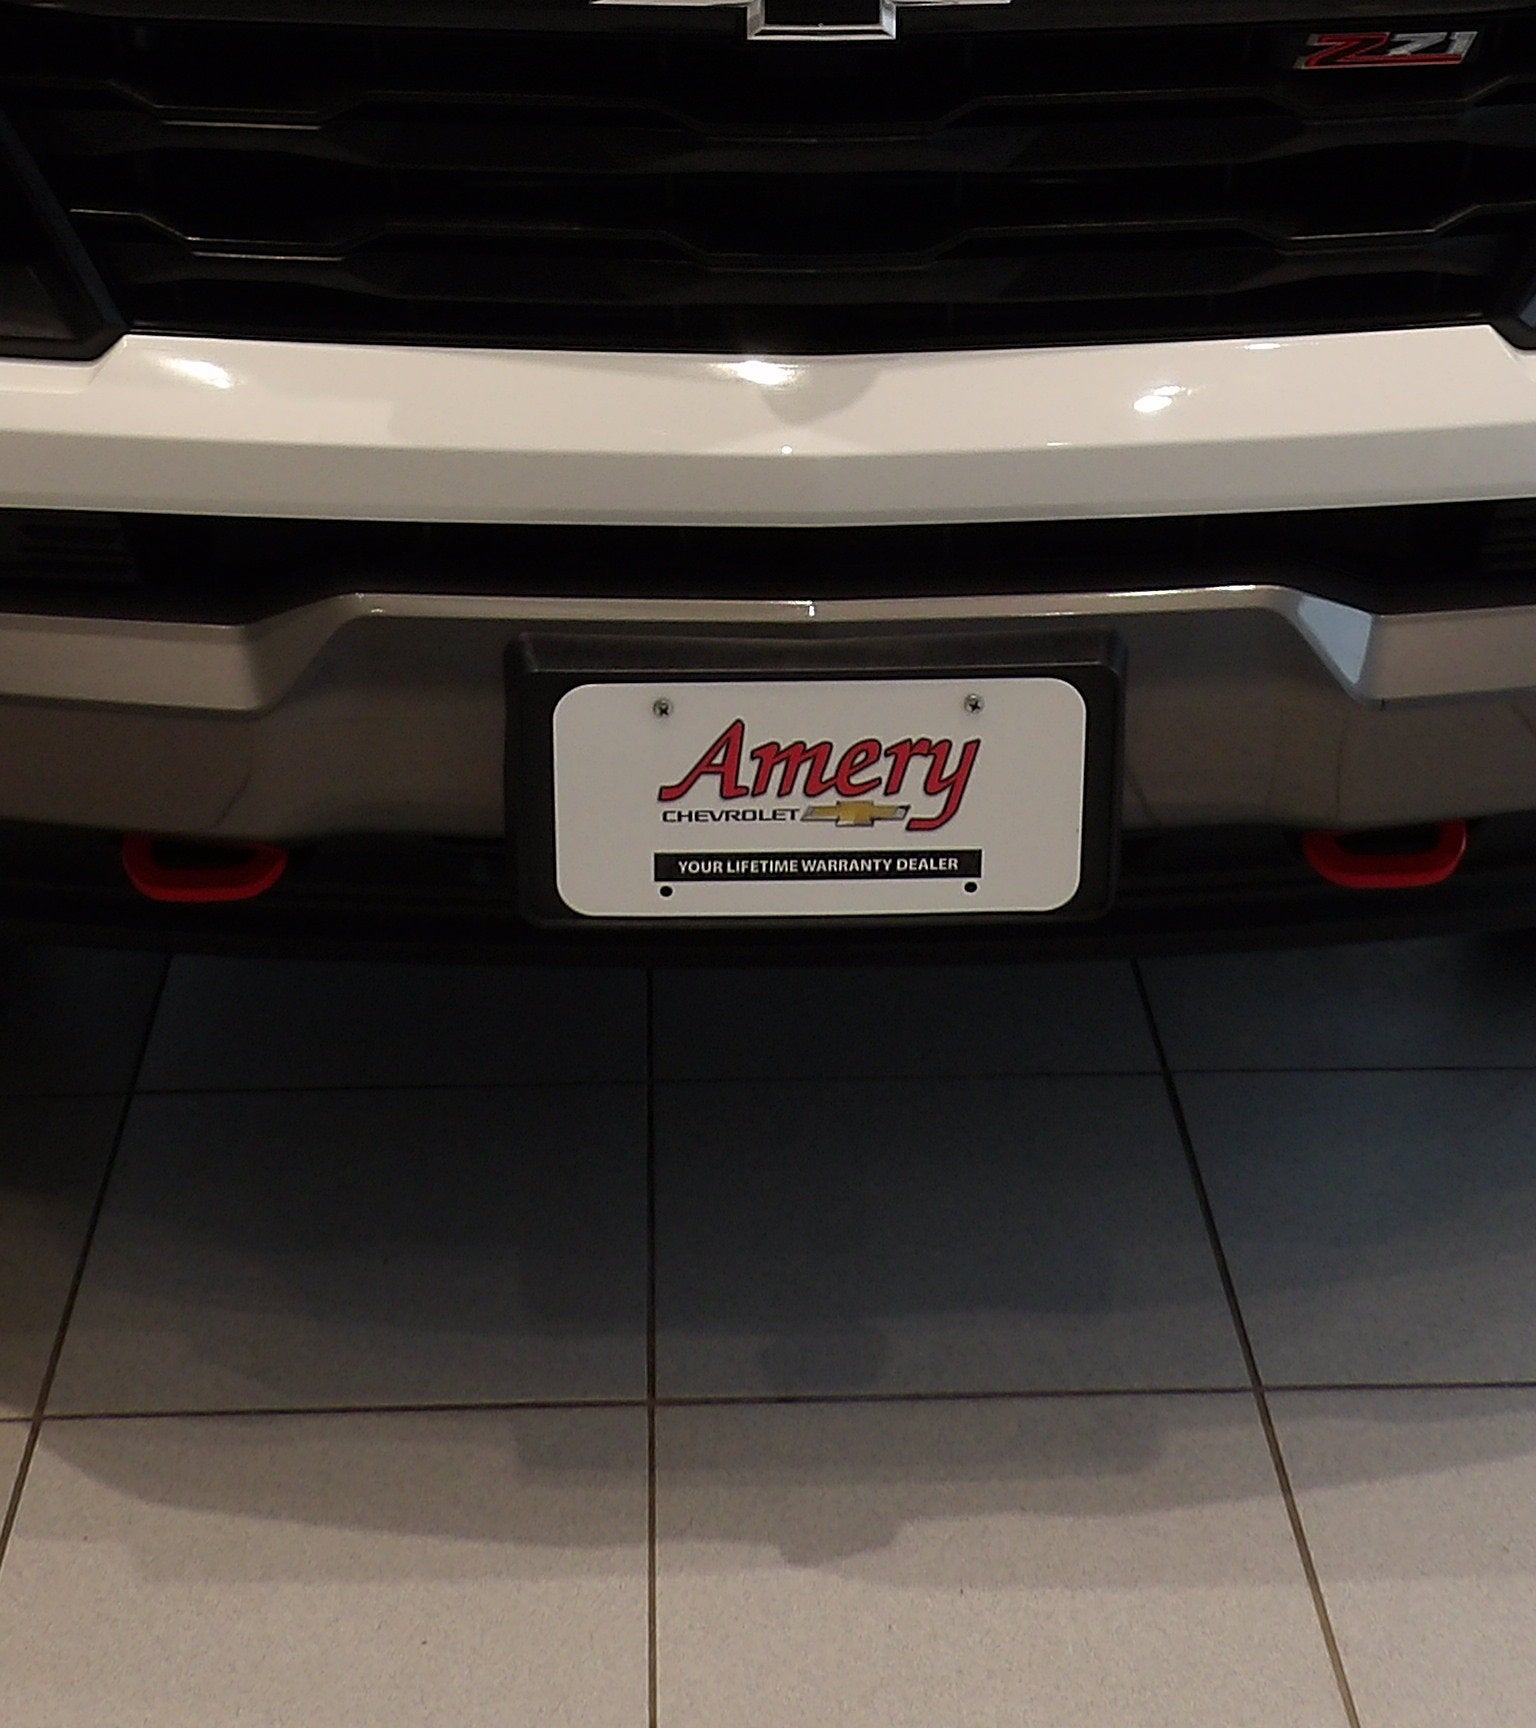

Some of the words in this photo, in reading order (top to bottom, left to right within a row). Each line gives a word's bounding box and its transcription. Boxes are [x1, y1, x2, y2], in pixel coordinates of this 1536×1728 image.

[1294, 30, 1478, 70] Z71
[658, 718, 982, 832] Amery
[662, 808, 801, 823] CHEVROLET
[677, 859, 724, 875] YOUR
[726, 858, 799, 874] LIFETIME
[801, 857, 893, 873] WARRANTY
[896, 856, 959, 872] DEALER
